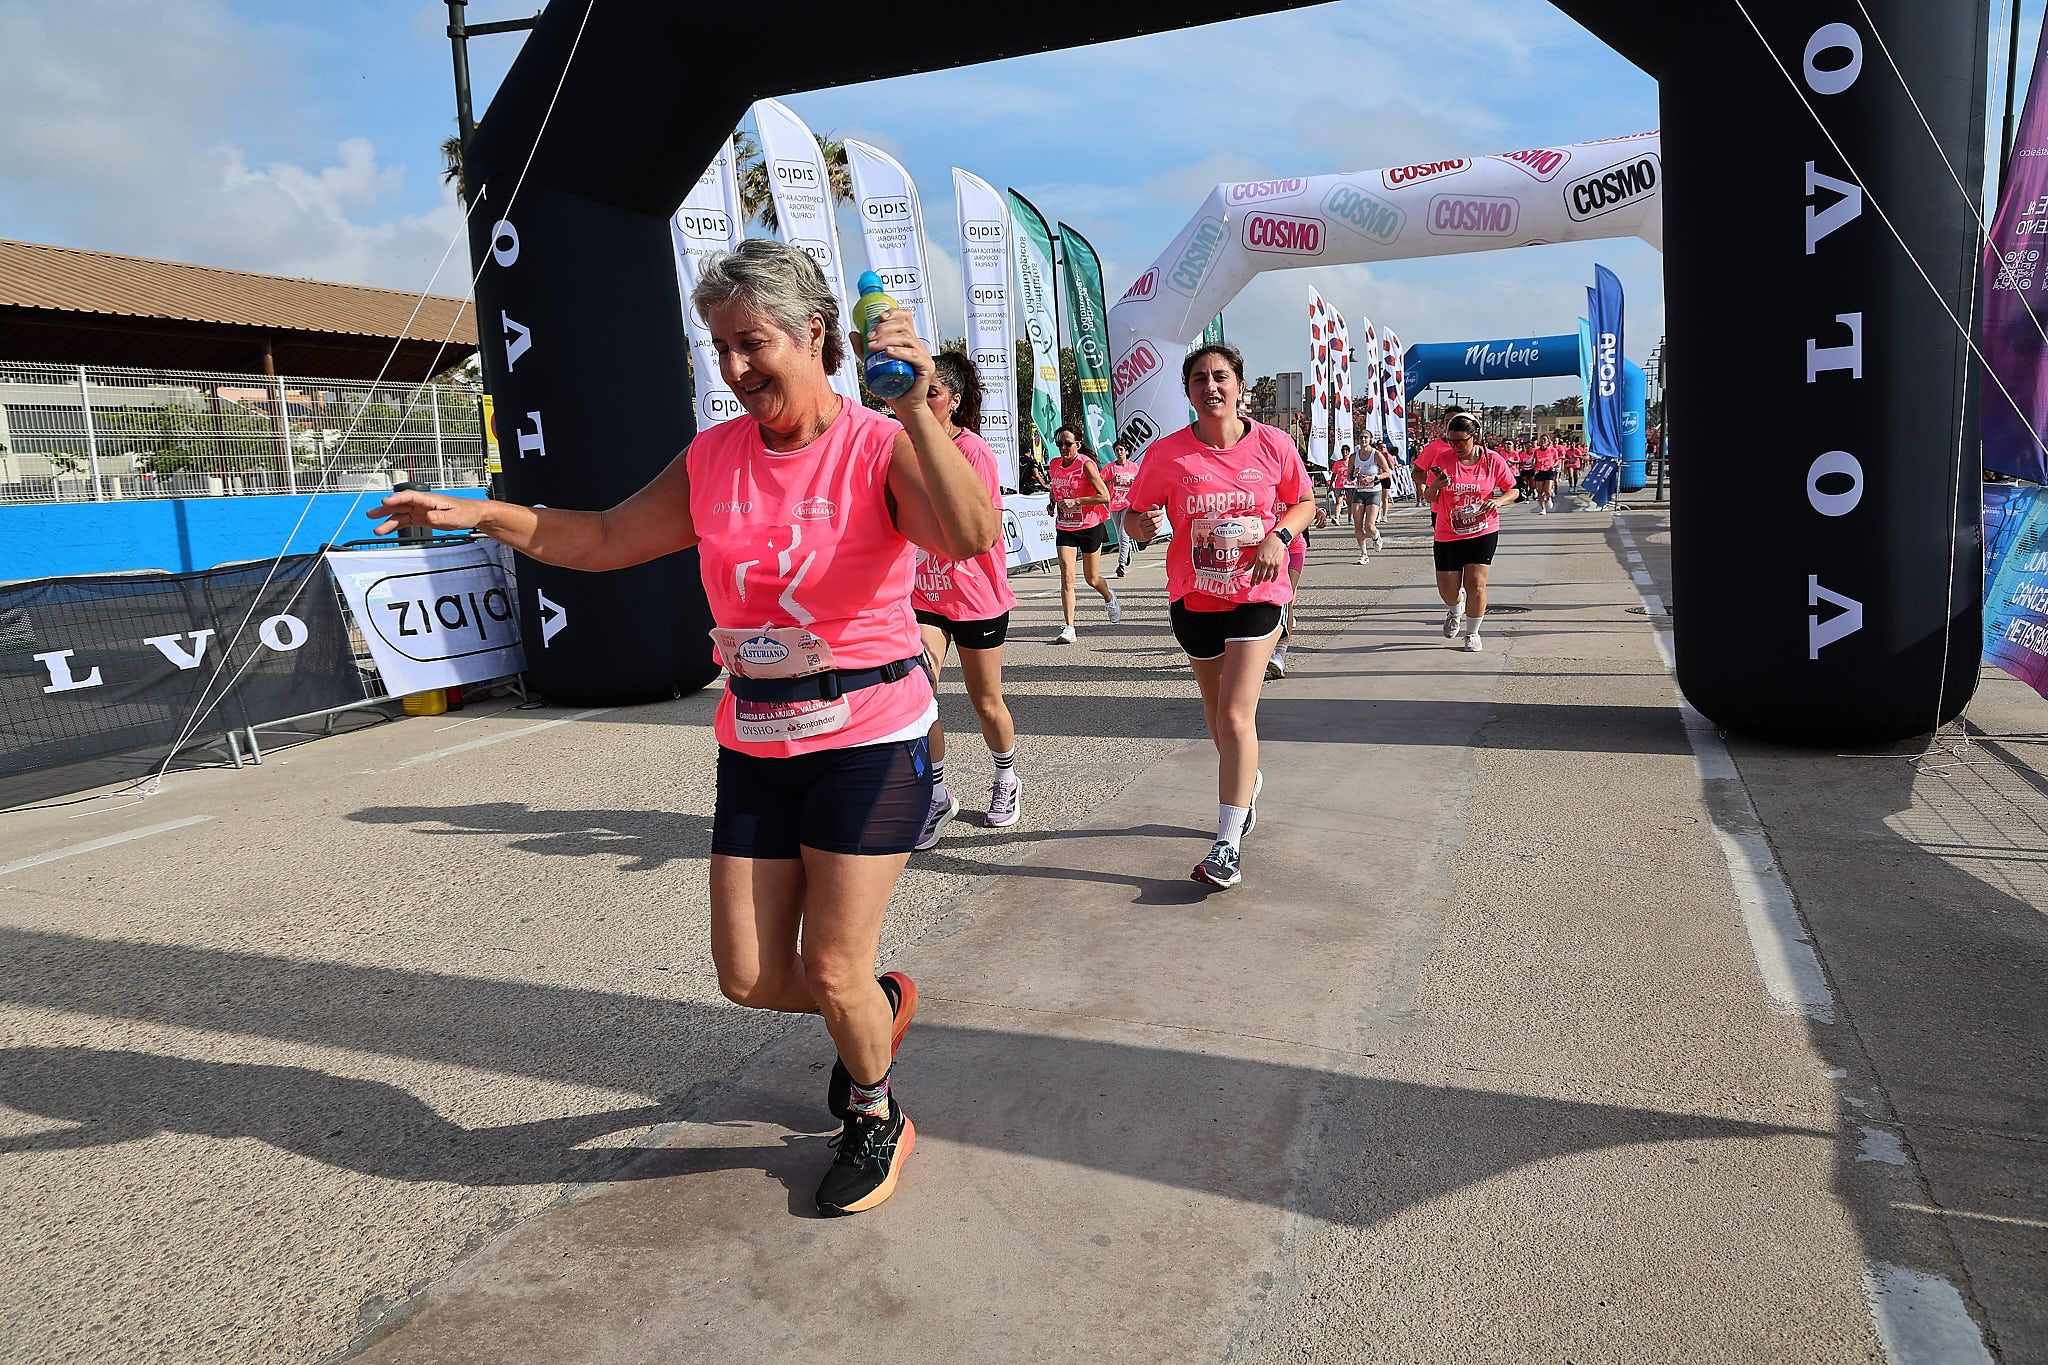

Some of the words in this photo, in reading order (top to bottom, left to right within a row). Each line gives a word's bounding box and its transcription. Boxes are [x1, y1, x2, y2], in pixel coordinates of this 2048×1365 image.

[1232, 178, 1301, 201] COSMO
[1573, 159, 1656, 215] COSMO
[1328, 187, 1399, 239] COSMO
[1435, 200, 1511, 232] COSMO
[1250, 216, 1319, 251] COSMO
[1172, 221, 1225, 291] COSMO
[1804, 22, 1864, 660] VOLVO
[1112, 346, 1156, 401] OSMO
[1464, 341, 1539, 375] Marlene
[492, 220, 569, 649] VLVO
[1183, 474, 1213, 484] OYSHO
[713, 500, 753, 515] OYSHO
[1187, 492, 1256, 515] CARRERA
[927, 554, 941, 574] LA
[1216, 547, 1240, 561] 016
[386, 587, 513, 641] ziaja
[33, 614, 309, 694] LVO
[742, 647, 786, 658] ASTURIANA
[775, 710, 796, 718] MUJER
[800, 700, 832, 713] VALENCIA
[796, 715, 836, 731] Santander
[742, 725, 774, 735] OYSHO
